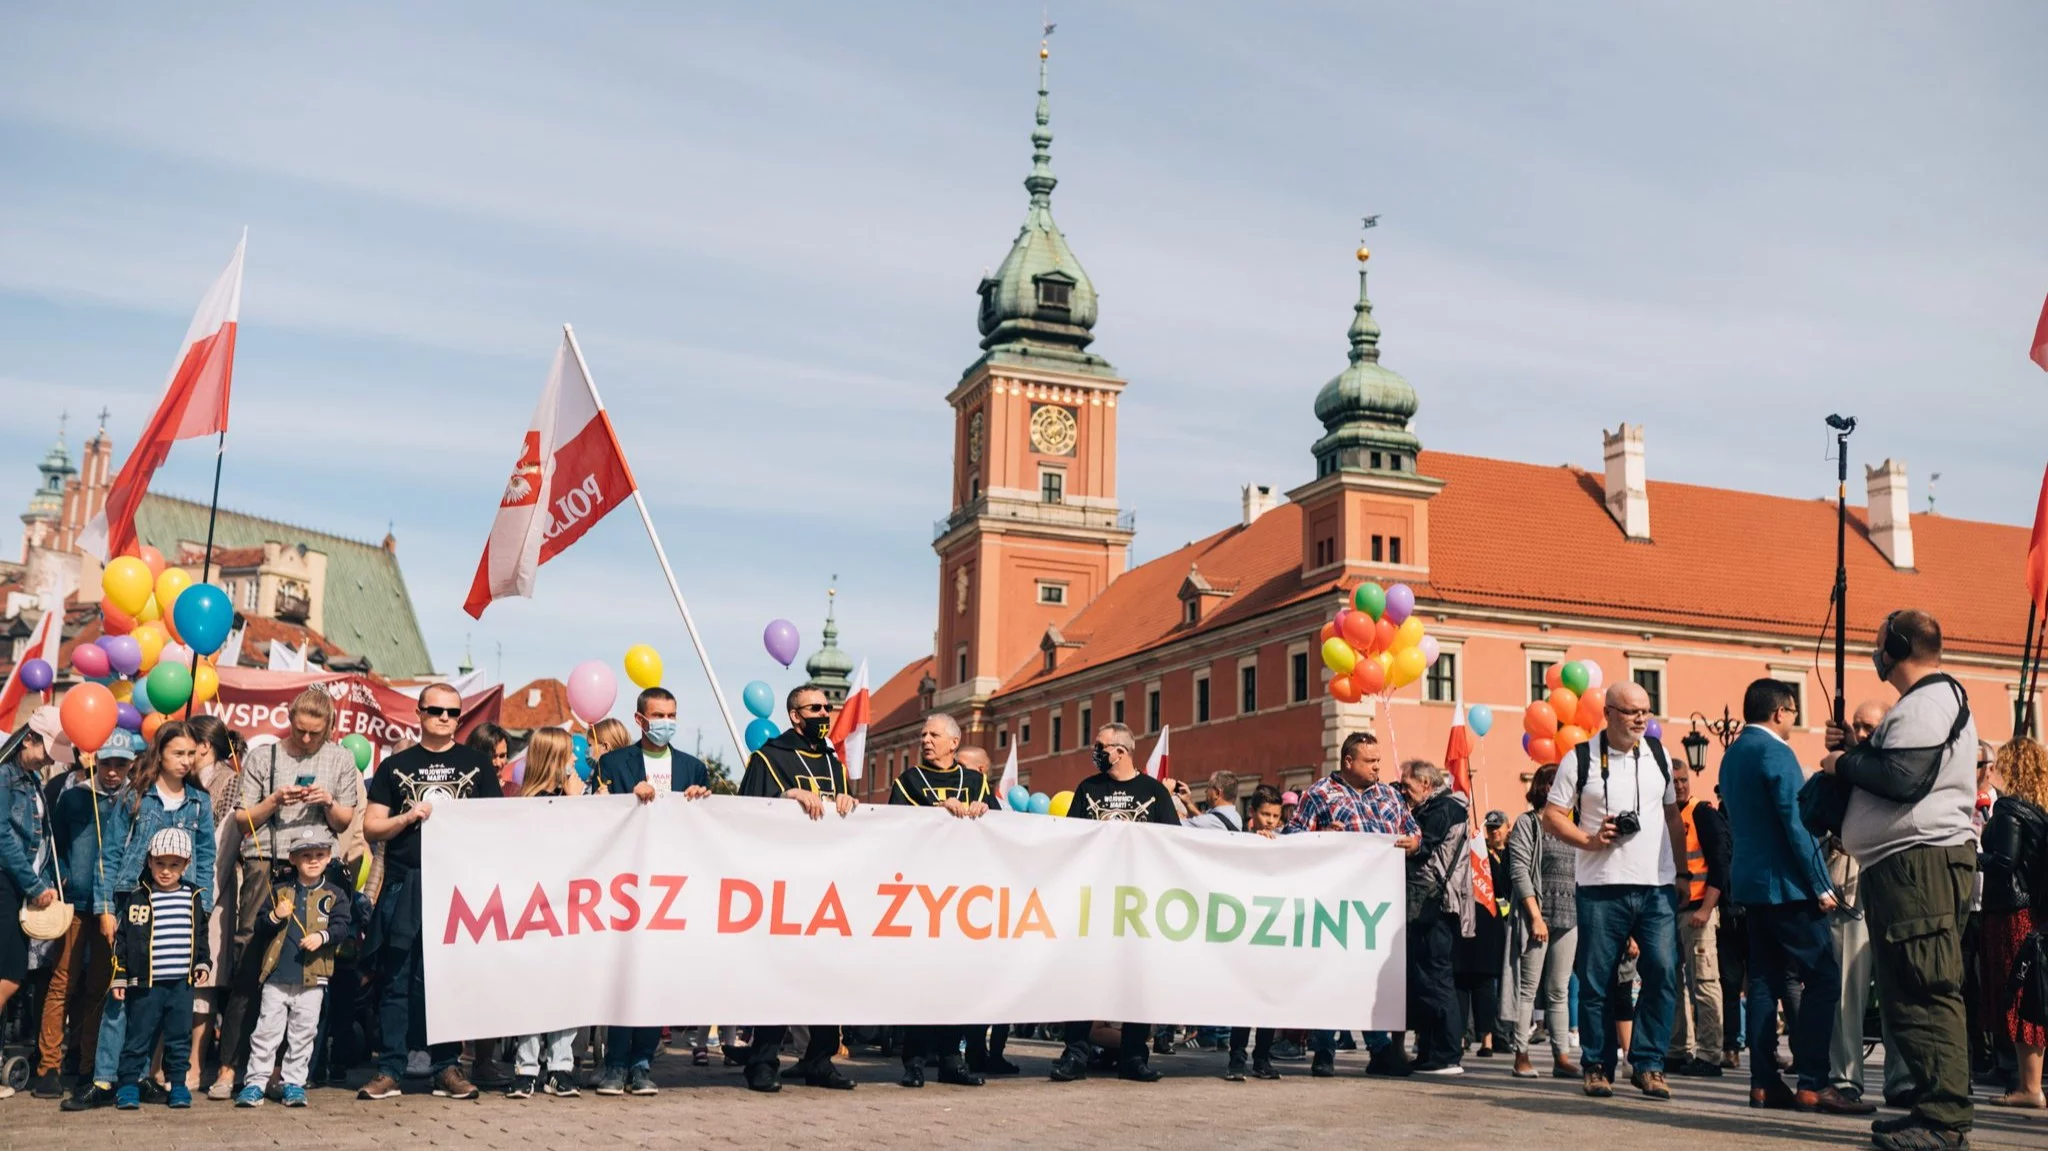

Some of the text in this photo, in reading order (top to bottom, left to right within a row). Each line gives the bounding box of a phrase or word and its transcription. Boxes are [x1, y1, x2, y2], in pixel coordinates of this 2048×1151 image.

[129, 904, 150, 923] 68
[443, 872, 1392, 951] MARSZ DLA ŻYCIA I RODZINY
